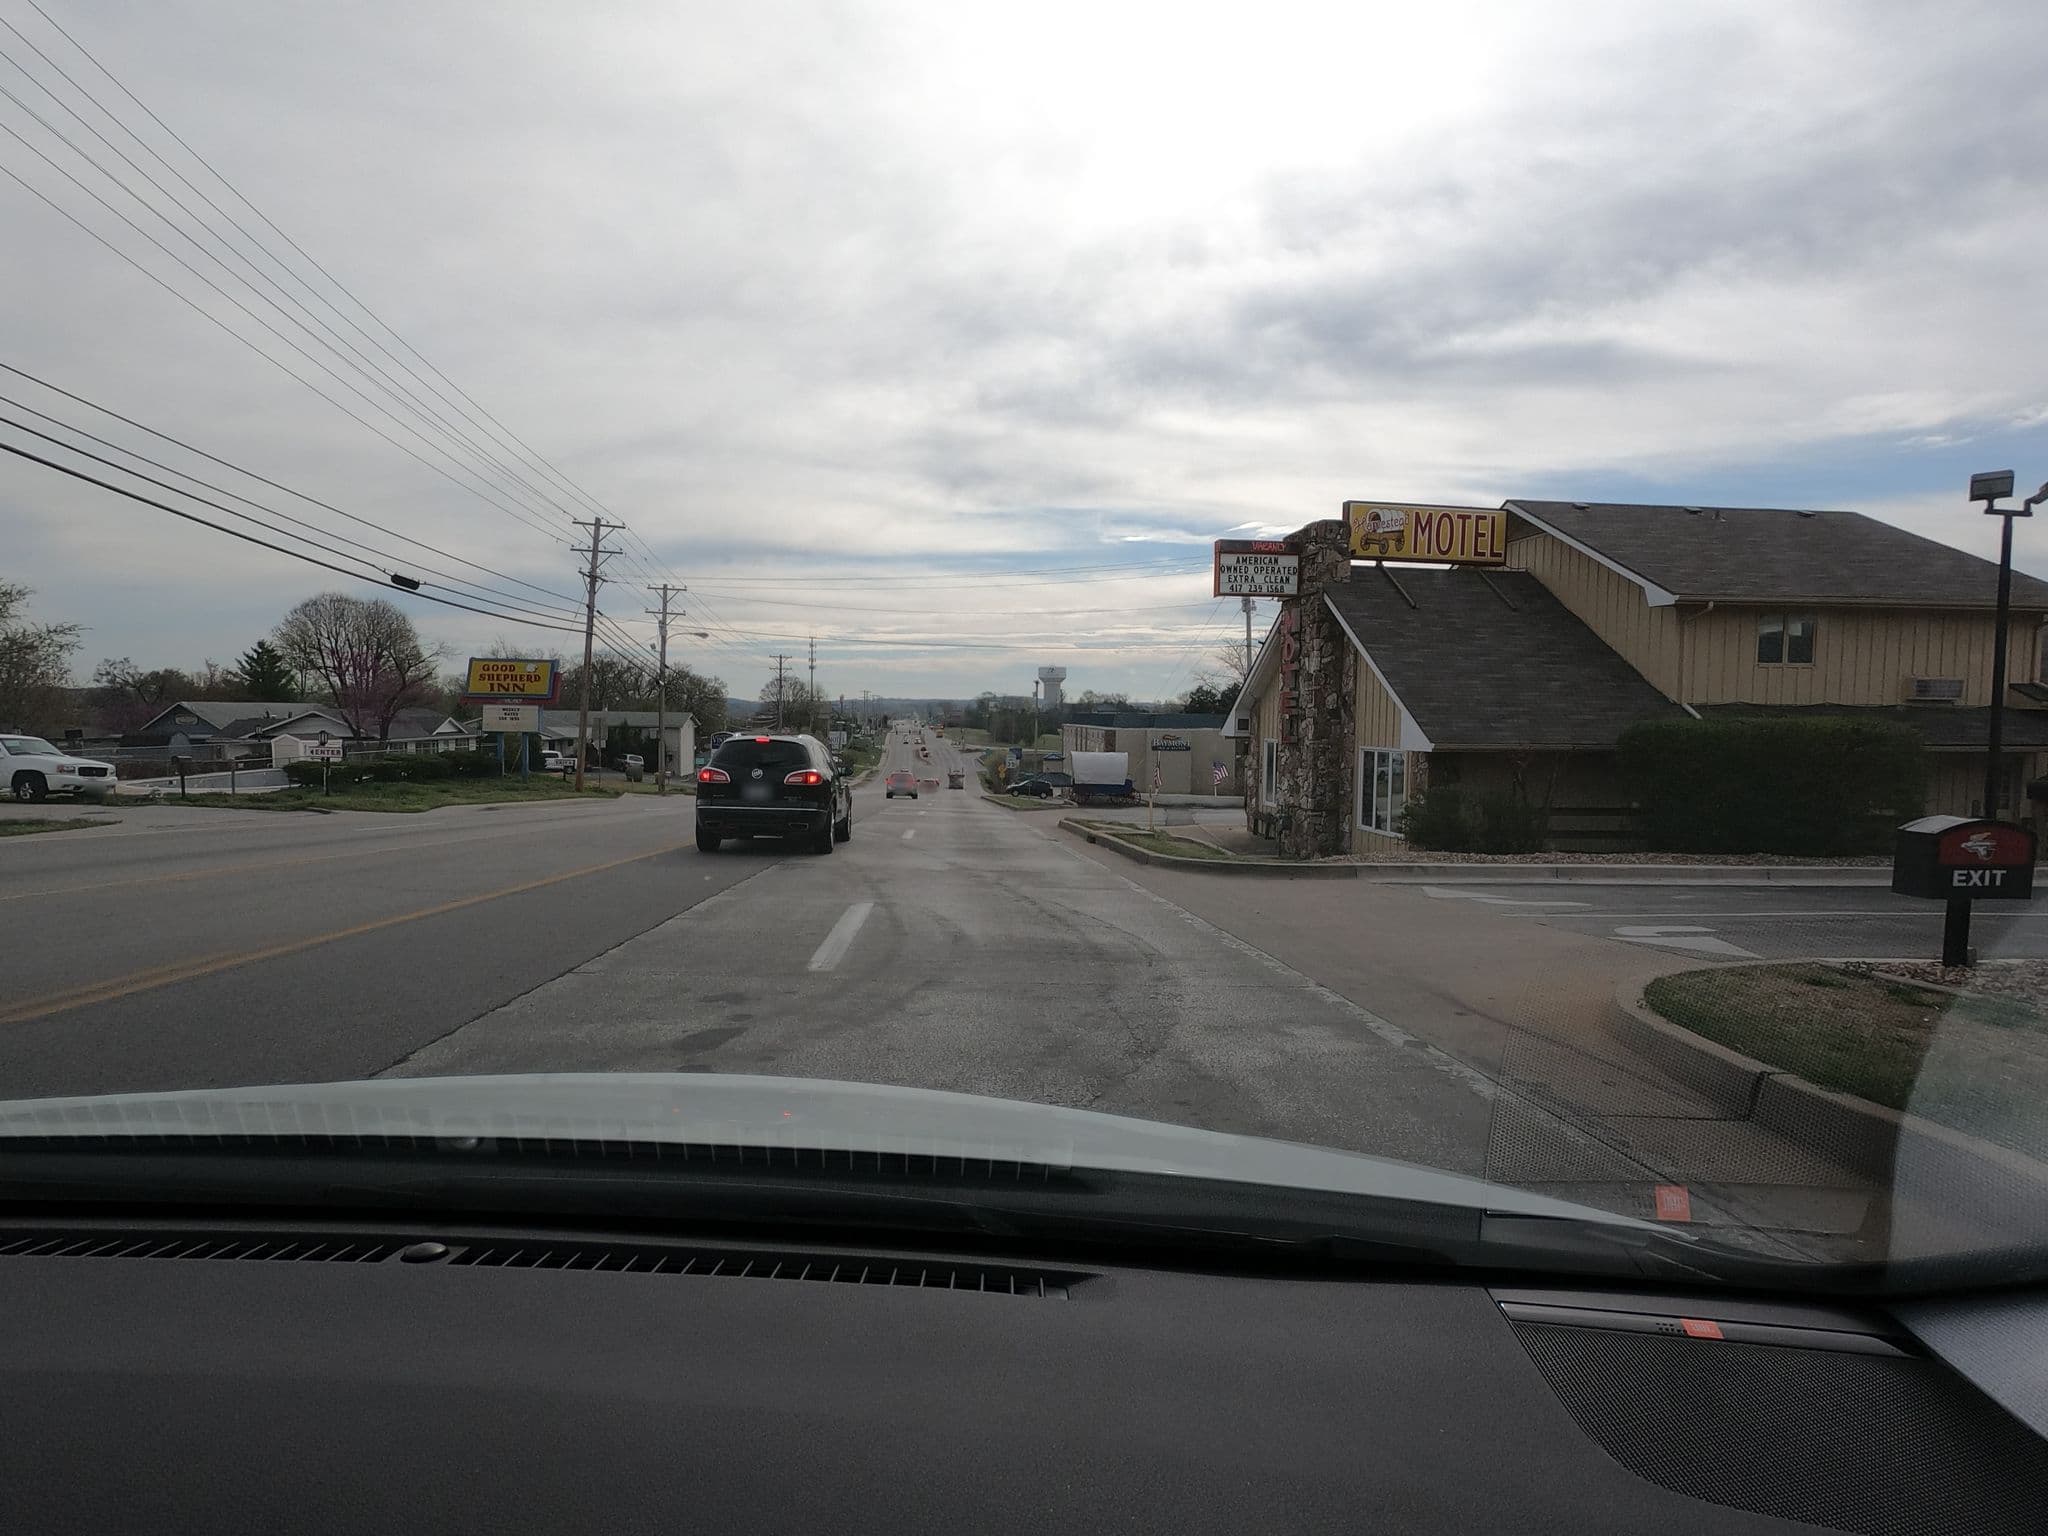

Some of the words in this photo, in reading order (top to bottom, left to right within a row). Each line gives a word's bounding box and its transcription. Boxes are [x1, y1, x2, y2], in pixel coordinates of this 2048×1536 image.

[1413, 511, 1503, 558] MOTEL
[1235, 556, 1279, 565] AMERICAN
[1220, 565, 1249, 574] OWNED
[1253, 566, 1298, 575] OPERATED
[1228, 575, 1256, 583] EXTRA
[1263, 575, 1290, 584] CLEAN
[1229, 584, 1243, 592] 417
[1248, 584, 1263, 593] 239
[482, 663, 516, 672] GOOD
[478, 673, 541, 683] SHEPHERD
[489, 682, 526, 692] INN
[1152, 738, 1191, 747] BAYMONT
[1952, 869, 2007, 887] EXIT
